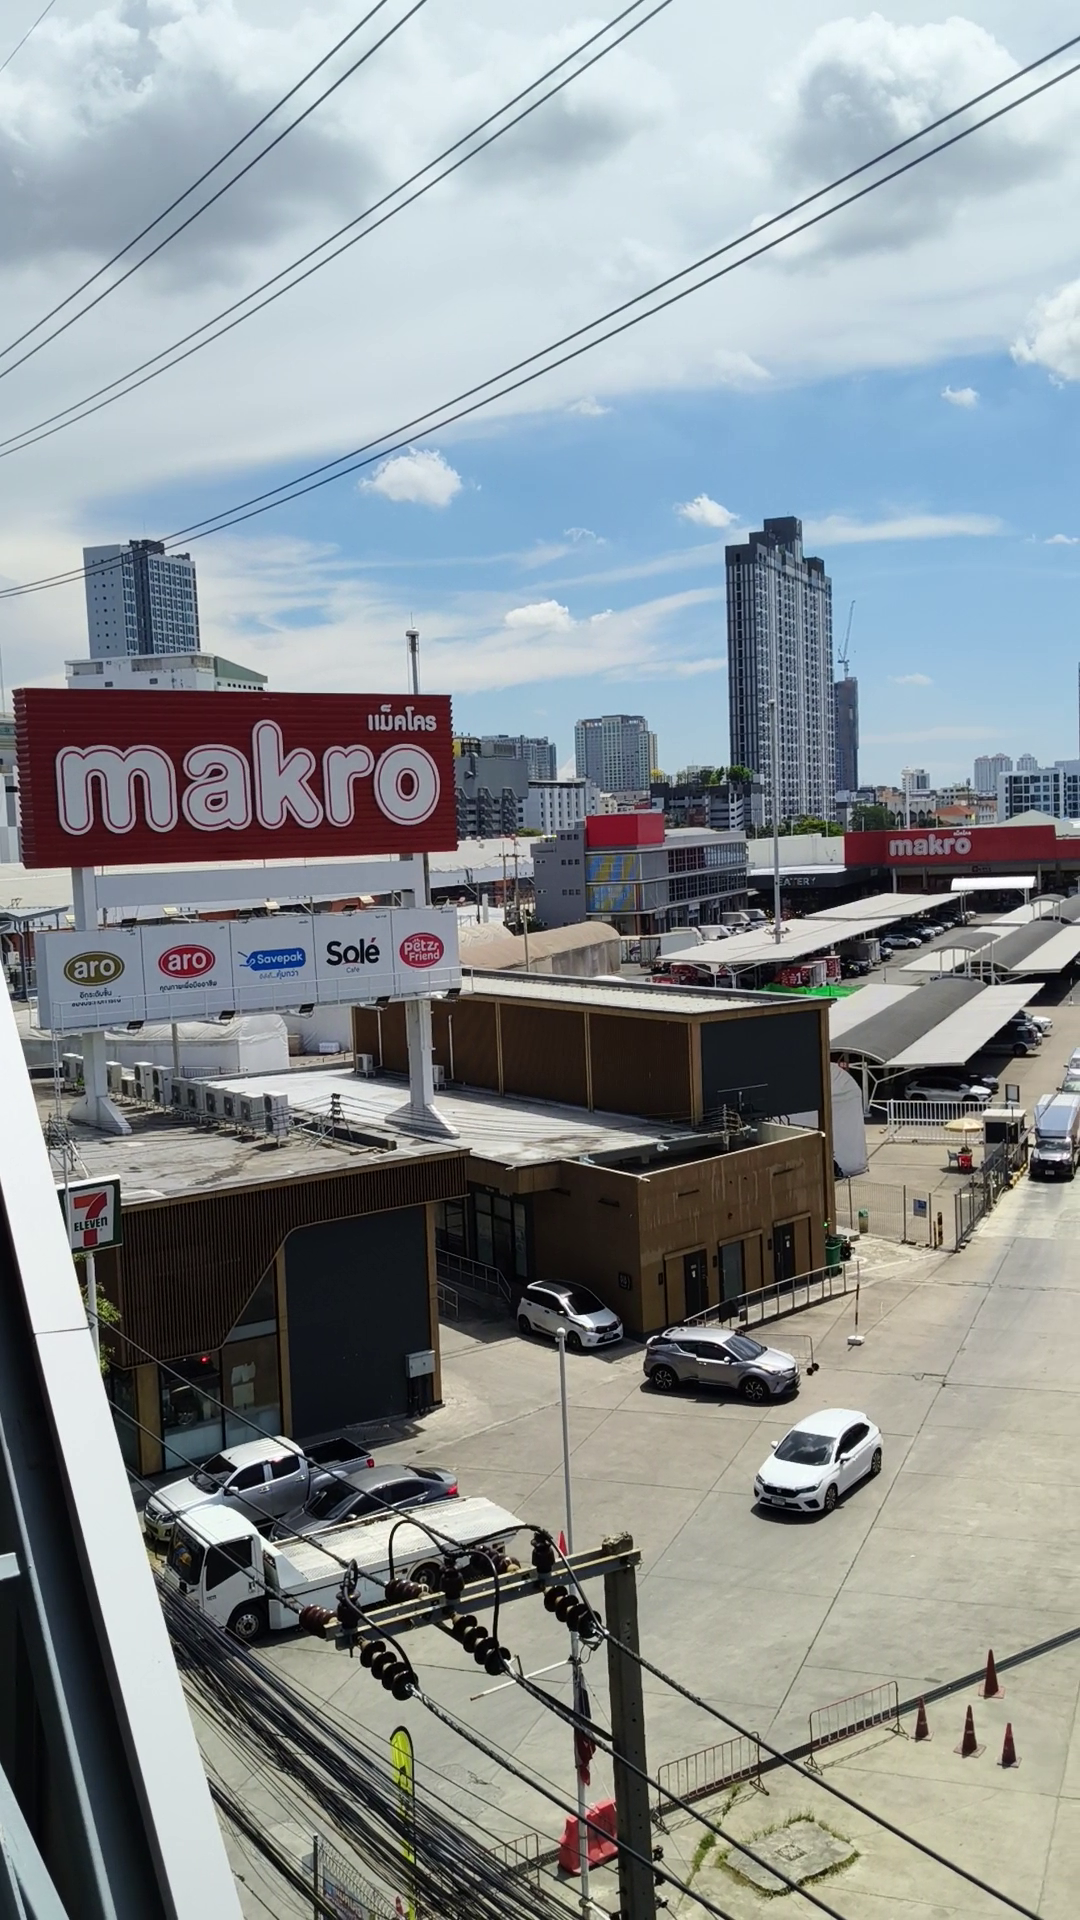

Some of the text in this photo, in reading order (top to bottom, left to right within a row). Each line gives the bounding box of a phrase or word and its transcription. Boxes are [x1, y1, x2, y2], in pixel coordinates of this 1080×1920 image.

[367, 704, 437, 731] แม็คโคร
[55, 719, 441, 836] makro
[889, 833, 972, 856] makro
[167, 952, 207, 971] aro
[257, 951, 303, 965] Savepak
[326, 937, 380, 966] Solé
[409, 948, 440, 962] Friend
[74, 959, 116, 979] aro
[73, 1191, 108, 1247] 7
